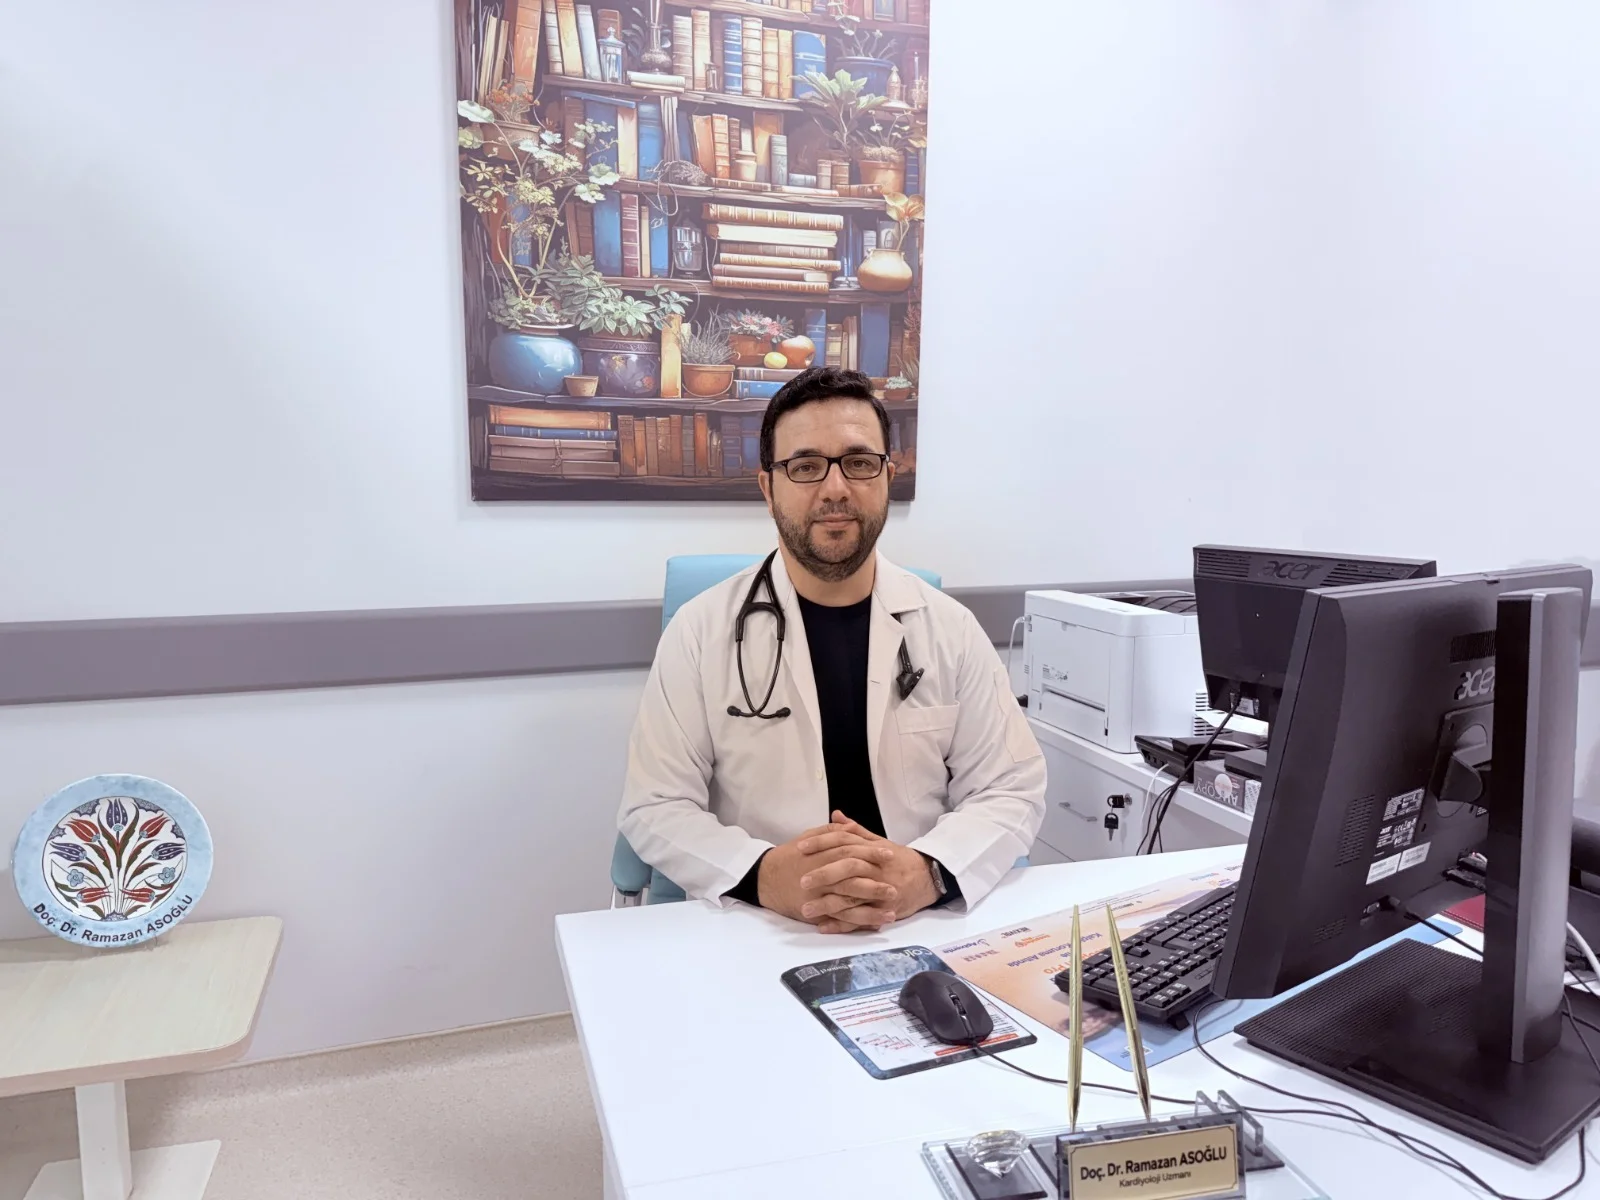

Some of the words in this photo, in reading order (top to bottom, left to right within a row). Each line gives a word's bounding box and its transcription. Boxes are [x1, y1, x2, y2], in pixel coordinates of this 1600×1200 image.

[1260, 560, 1324, 580] acer
[1454, 666, 1496, 700] ace
[33, 902, 56, 927] Doç.
[60, 921, 78, 936] Dr.
[81, 929, 143, 943] Ramazan
[146, 894, 193, 933] ASOĞLU
[1080, 1166, 1105, 1181] Doç.
[1107, 1163, 1124, 1176] Dr.
[1125, 1156, 1177, 1174] Ramazan
[1179, 1145, 1227, 1166] ASOĞLU
[1119, 1175, 1161, 1188] Kardiyoloji
[1162, 1171, 1191, 1181] Uzmanı
